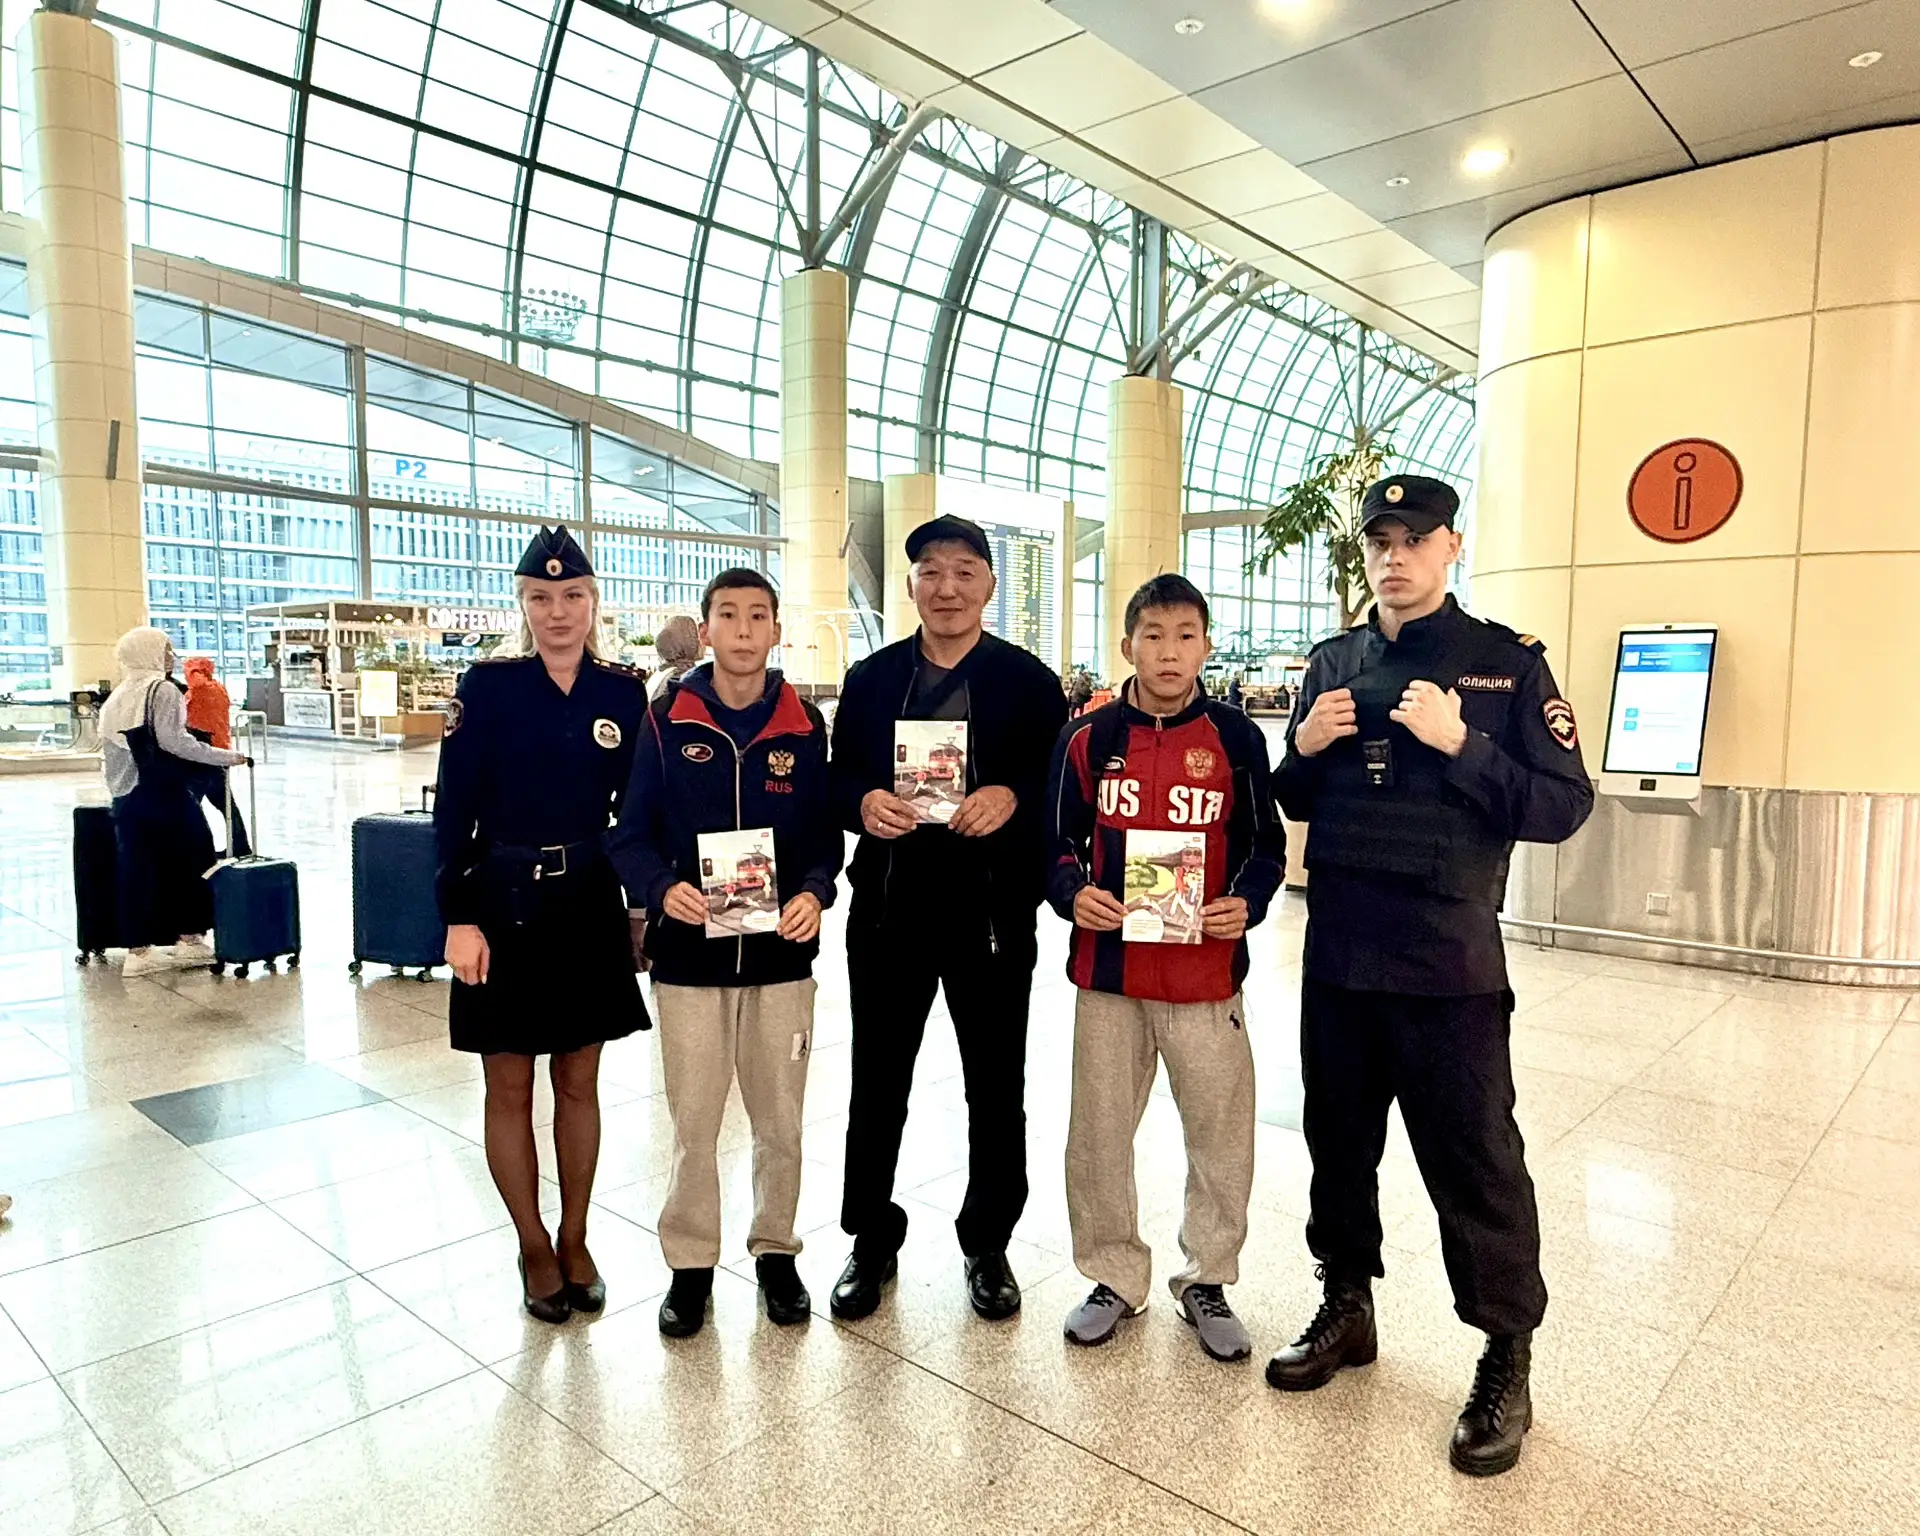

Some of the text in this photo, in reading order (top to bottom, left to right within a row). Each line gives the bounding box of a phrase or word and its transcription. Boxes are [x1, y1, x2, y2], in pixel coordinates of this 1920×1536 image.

[395, 458, 427, 479] P2
[765, 779, 793, 793] RUS
[1098, 779, 1140, 817] US
